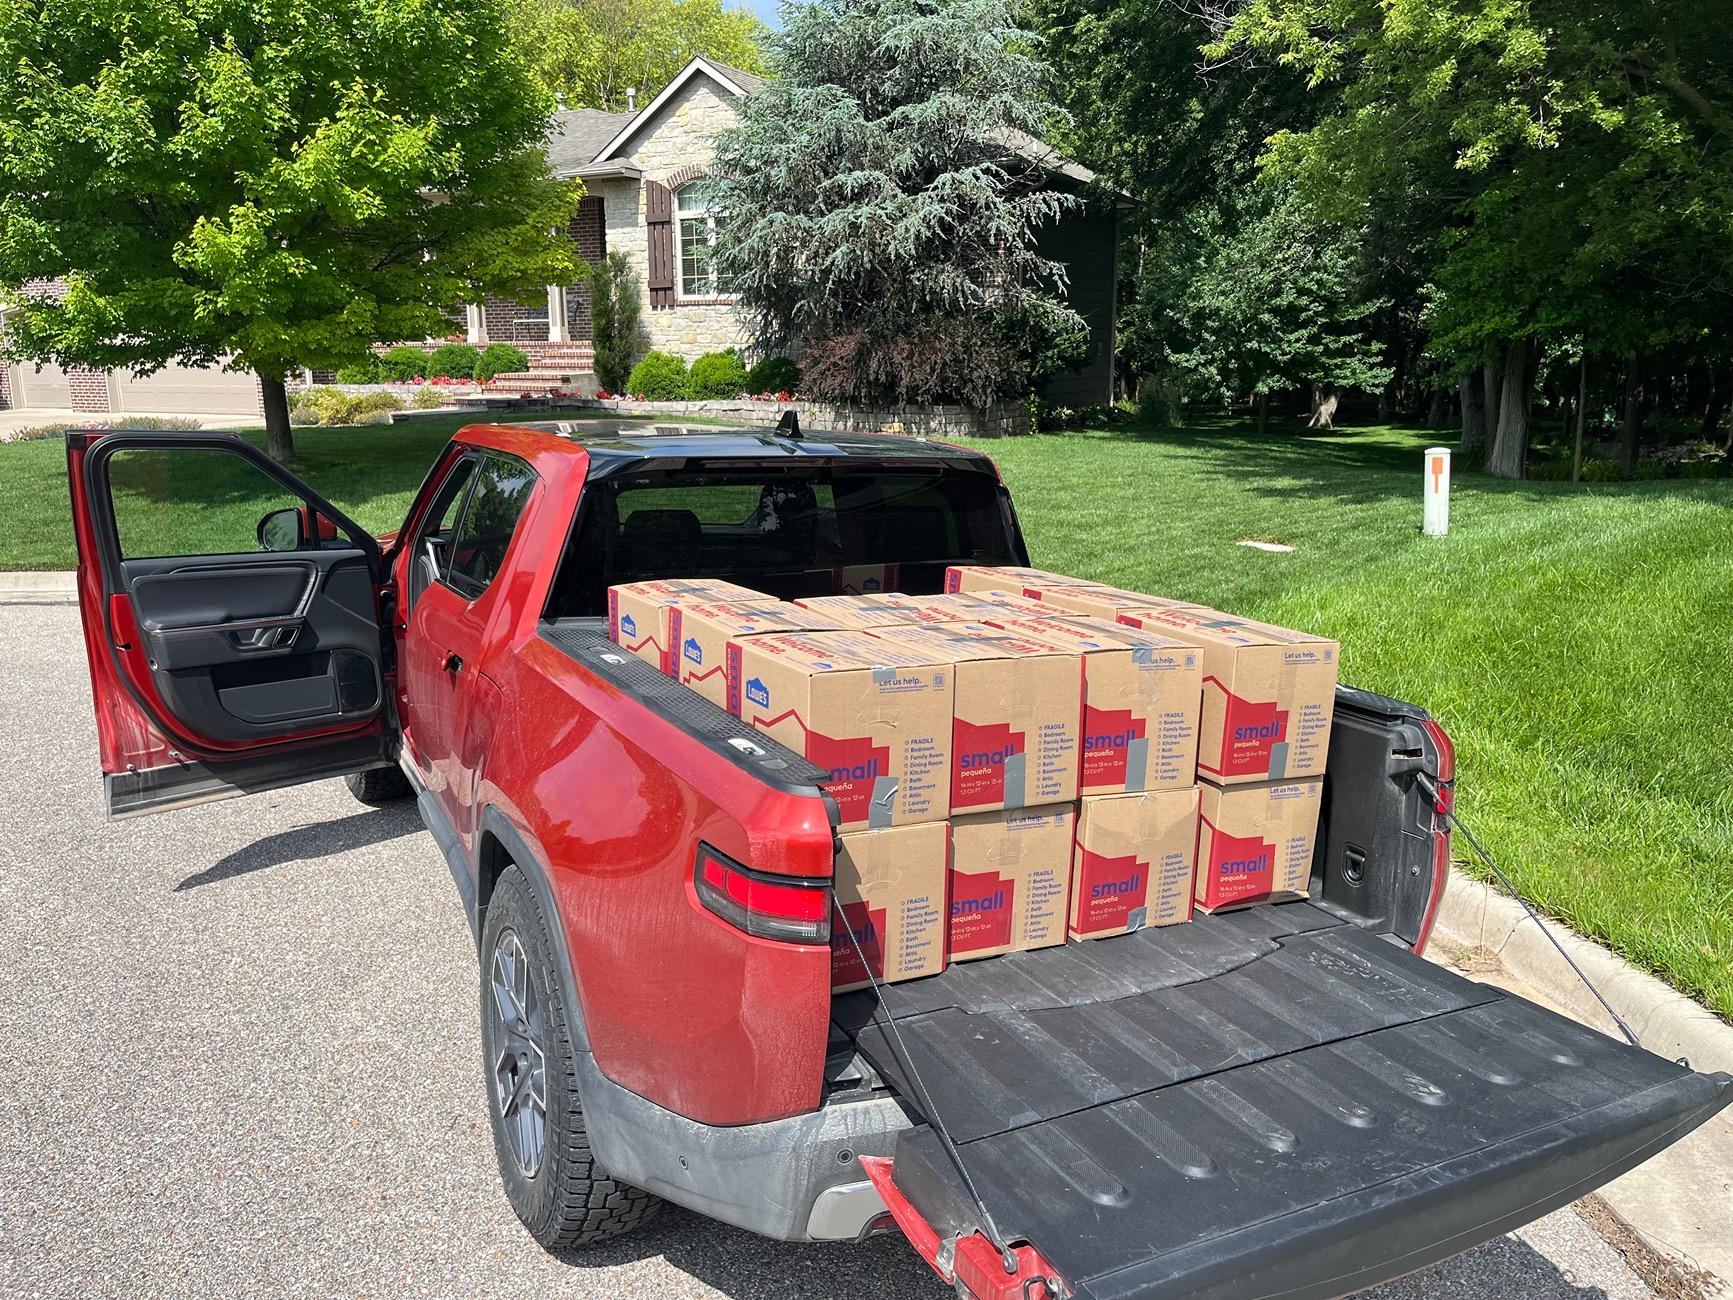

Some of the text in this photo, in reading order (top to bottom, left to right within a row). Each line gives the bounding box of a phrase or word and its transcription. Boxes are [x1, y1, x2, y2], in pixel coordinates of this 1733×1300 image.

[903, 677, 922, 686] help.
[748, 683, 767, 705] LOWE'S
[1235, 720, 1279, 740] small
[1234, 740, 1260, 750] pequeña
[1085, 750, 1114, 758] pequeña
[831, 758, 878, 781] mall
[960, 768, 992, 778] pequeña
[824, 782, 852, 792] equeña
[1220, 854, 1266, 874] small
[1220, 874, 1248, 882] pequeña
[1092, 874, 1138, 898] small
[906, 896, 929, 906] FRAGILE
[952, 891, 1004, 915] small
[1090, 896, 1118, 906] pequeña
[906, 904, 930, 912] Bedroom
[832, 923, 875, 946] mall
[906, 940, 932, 950] Basement
[904, 956, 926, 964] Laundry
[904, 964, 924, 972] Garage
